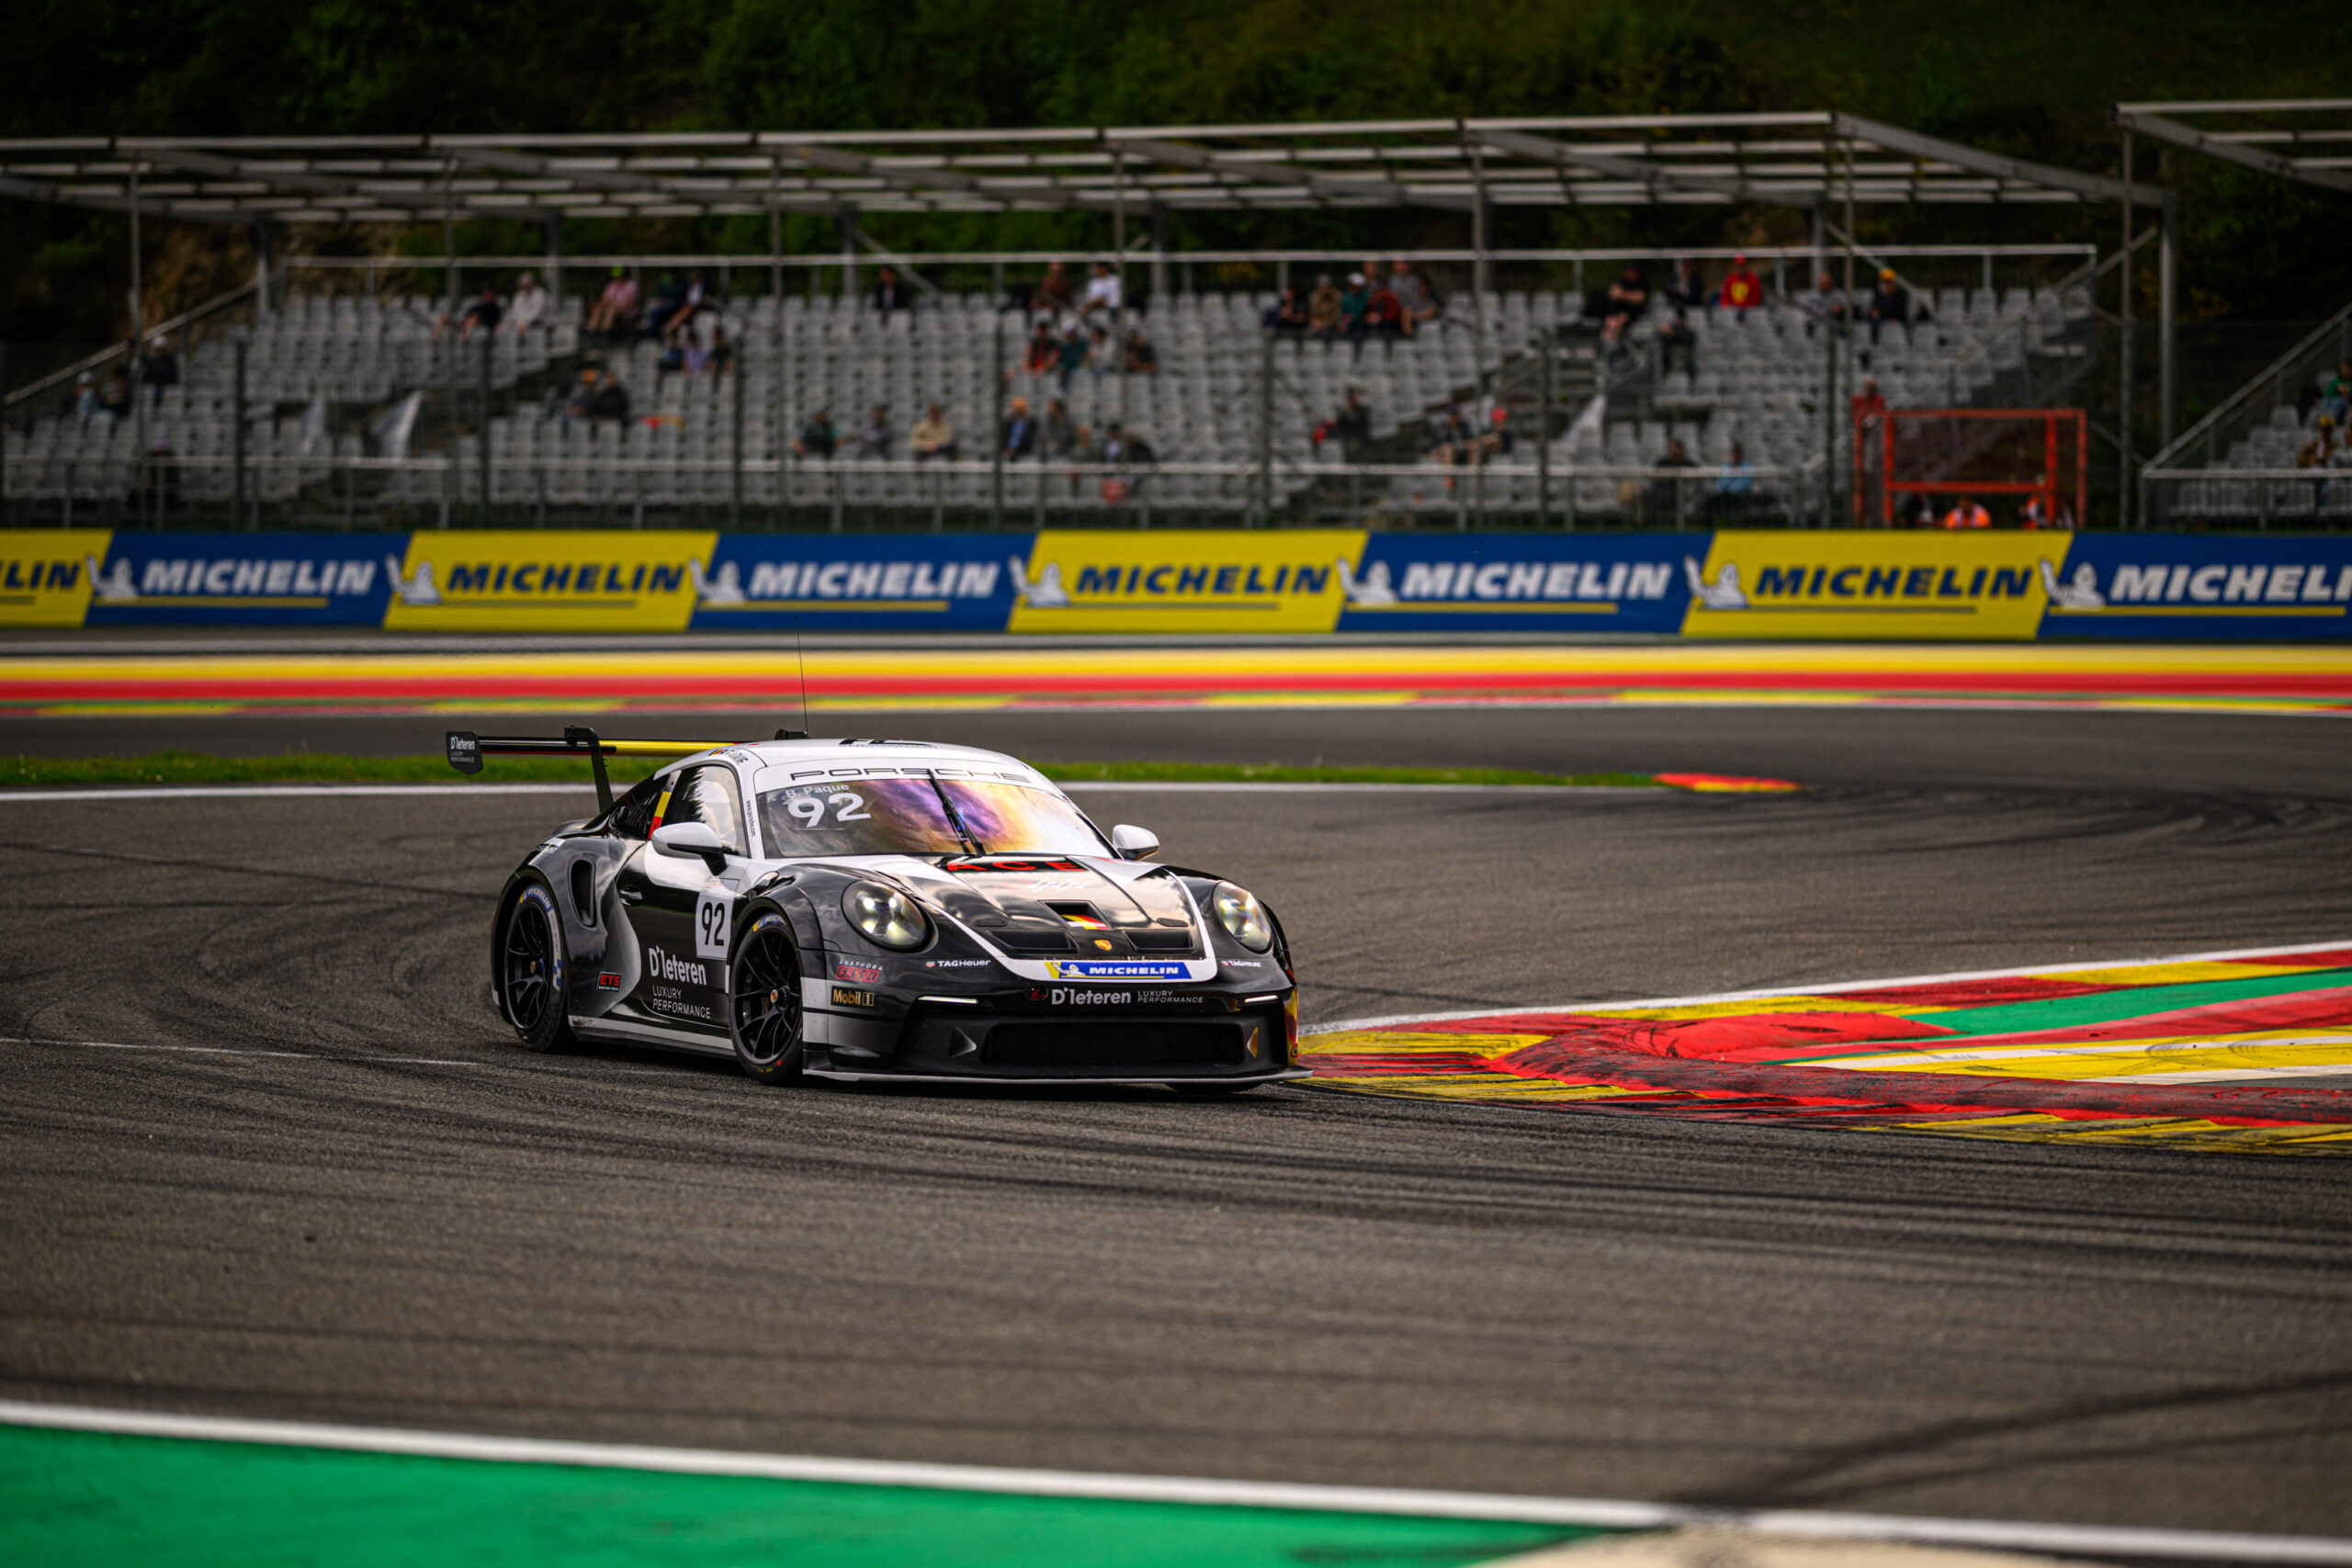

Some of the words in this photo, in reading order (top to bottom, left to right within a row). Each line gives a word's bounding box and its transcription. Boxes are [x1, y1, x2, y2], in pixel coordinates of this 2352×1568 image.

[0, 561, 81, 589] LIN
[141, 560, 376, 593] MICHELIN
[447, 563, 684, 592] MICHELIN
[747, 563, 1000, 596] MICHELIN
[1075, 565, 1330, 594] MICHELIN
[1400, 563, 1672, 599] MICHELIN
[1754, 566, 2034, 598] MICHELIN
[790, 767, 1031, 784] PORSCHE
[787, 793, 872, 829] 92
[701, 901, 726, 947] 92
[649, 944, 707, 986] D'Ieteren
[838, 967, 876, 981] FASSI
[1088, 966, 1180, 975] MICHELIN
[599, 974, 621, 987] ETS
[652, 985, 682, 999] LUXURY
[652, 998, 711, 1019] PERFORMANCE
[832, 987, 862, 1006] Mobil
[1051, 987, 1132, 1006] D'Ieteren
